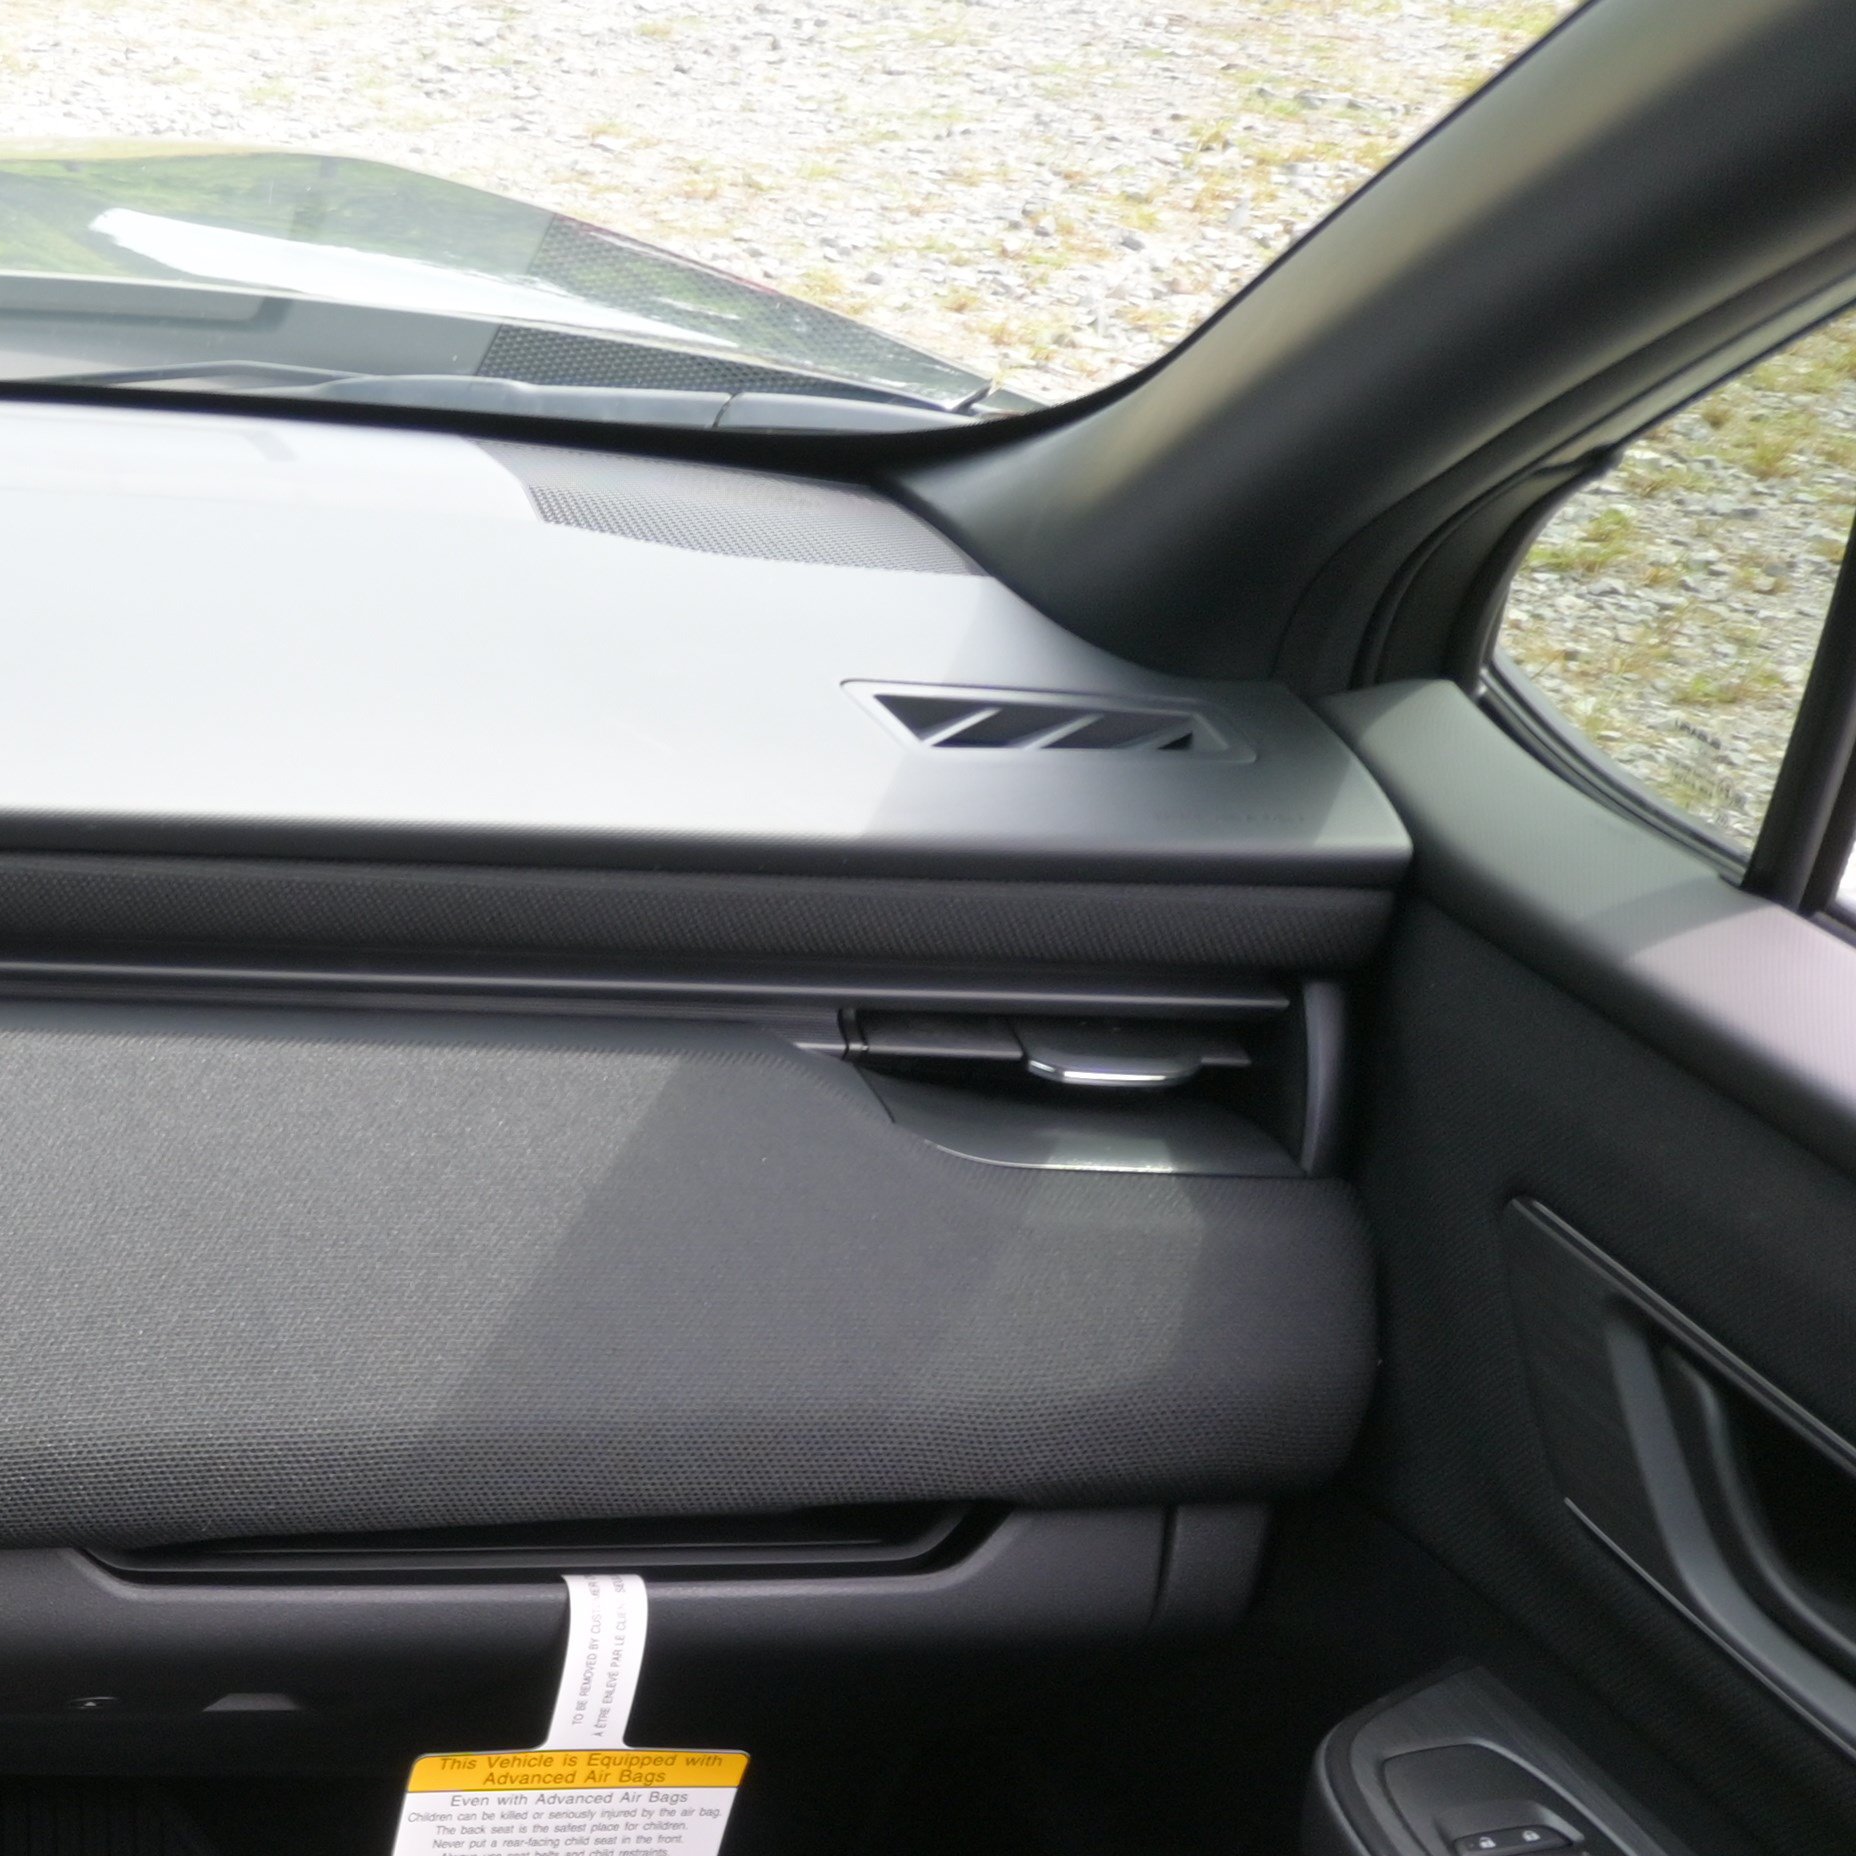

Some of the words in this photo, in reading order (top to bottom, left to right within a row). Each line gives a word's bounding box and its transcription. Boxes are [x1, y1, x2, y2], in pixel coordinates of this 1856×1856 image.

[572, 1711, 585, 1726] TO
[440, 1757, 477, 1771] This
[488, 1754, 554, 1769] Vehicle
[563, 1754, 578, 1767] is
[588, 1753, 677, 1770] Equipped
[686, 1755, 723, 1767] with
[483, 1772, 576, 1786] Advanced
[584, 1770, 611, 1784] Air
[619, 1770, 666, 1787] Bags
[451, 1795, 490, 1807] Even
[497, 1794, 529, 1806] with
[534, 1792, 614, 1806] Advanced
[619, 1792, 643, 1804] Air
[649, 1791, 689, 1806] Bags
[407, 1812, 453, 1823] Children
[457, 1813, 478, 1822] can
[482, 1811, 496, 1821] be
[500, 1811, 529, 1821] killed
[533, 1812, 545, 1820] or
[600, 1809, 638, 1819] injured
[641, 1808, 655, 1820] by
[659, 1808, 676, 1818] the
[680, 1808, 696, 1817] air
[699, 1807, 722, 1819] bag.
[436, 1825, 457, 1835] The
[461, 1825, 486, 1835] back
[491, 1825, 515, 1835] seat
[519, 1825, 528, 1834] is
[533, 1824, 549, 1833] the
[554, 1823, 587, 1833] safest
[590, 1822, 620, 1833] place
[625, 1822, 639, 1831] for
[642, 1822, 689, 1831] children.
[432, 1839, 465, 1850] Never
[468, 1839, 487, 1850] put
[503, 1837, 561, 1849] rear-facing
[564, 1836, 590, 1846] child
[594, 1836, 618, 1845] seat
[622, 1835, 632, 1844] in
[636, 1835, 653, 1844] the
[657, 1835, 684, 1844] front.
